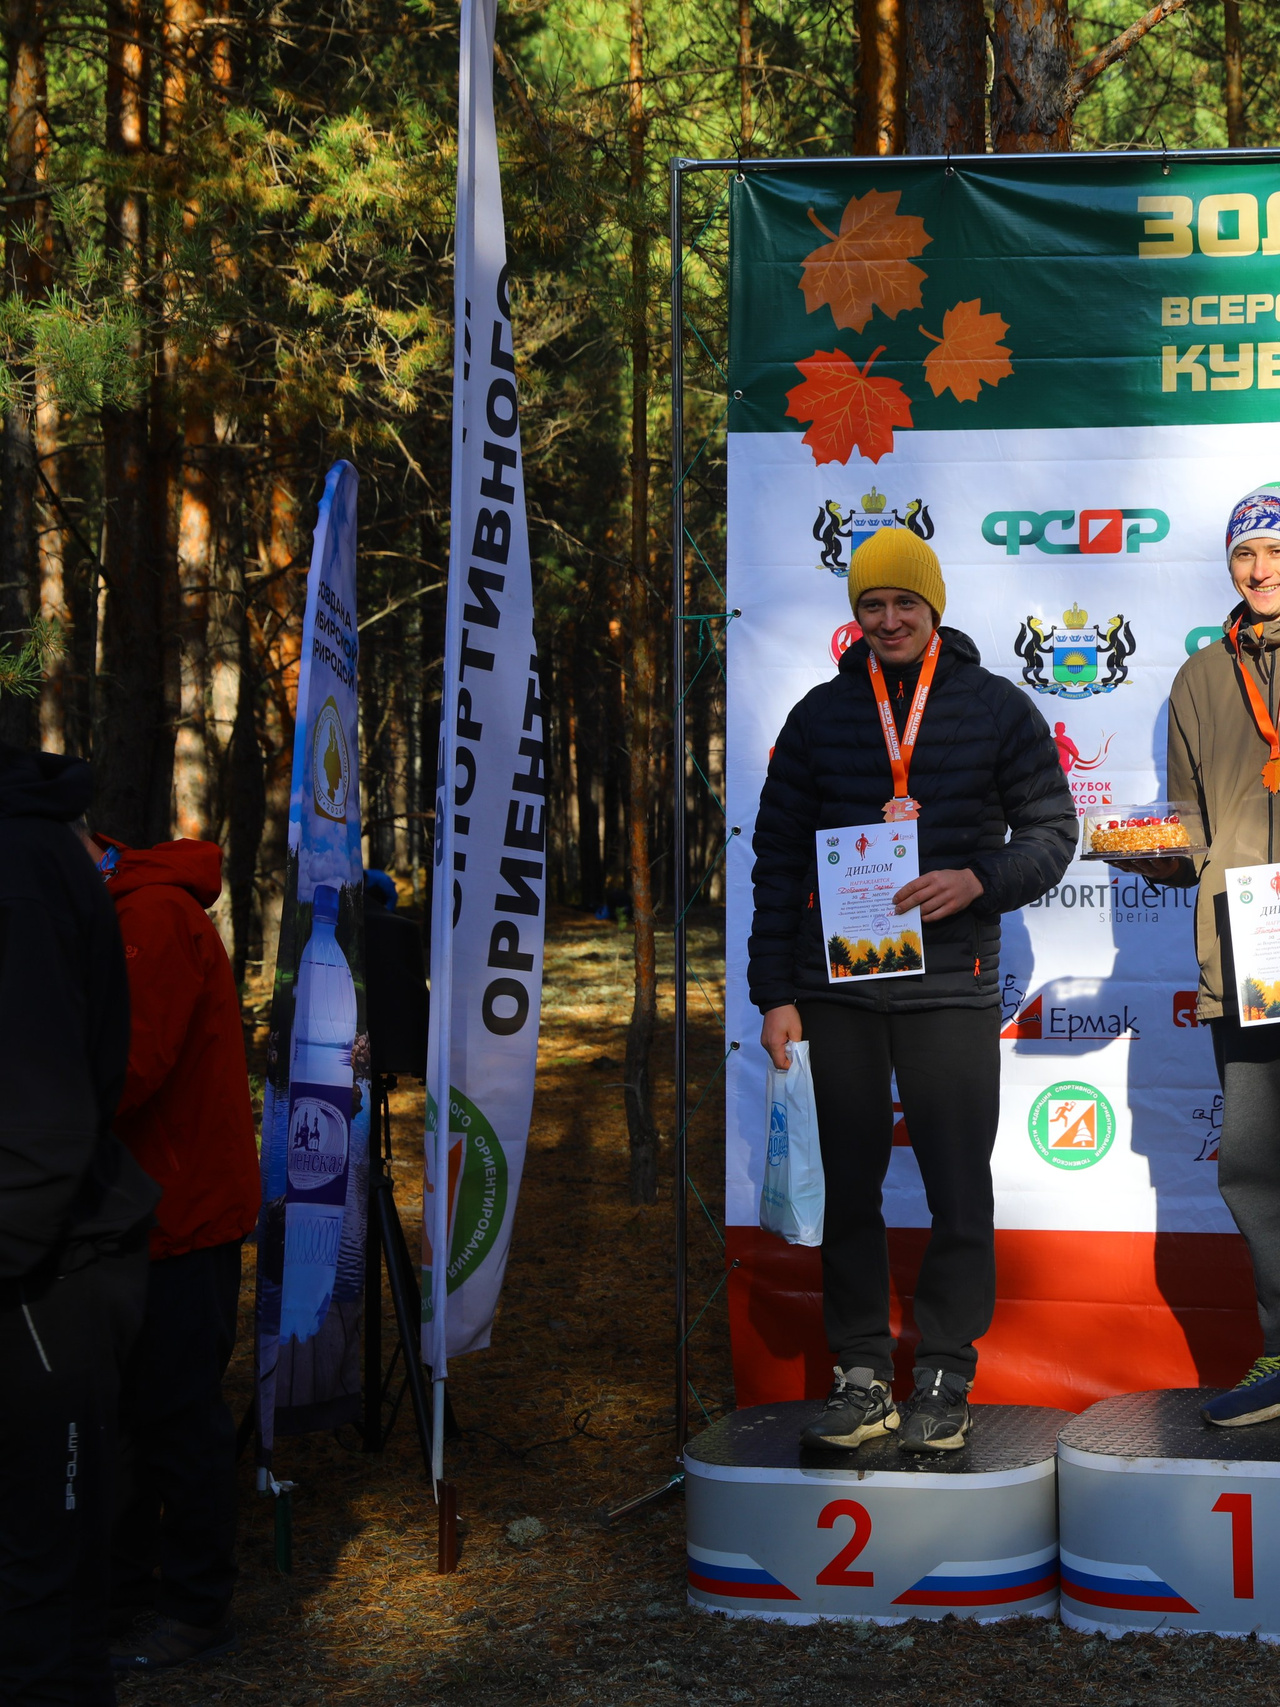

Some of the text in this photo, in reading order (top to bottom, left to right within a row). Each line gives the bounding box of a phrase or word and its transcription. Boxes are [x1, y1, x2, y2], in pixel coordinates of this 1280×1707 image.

[917, 685, 929, 711] ОСЕНЬ
[1071, 781, 1112, 792] КУБОК
[904, 801, 914, 811] 2
[845, 863, 893, 878] ДИПЛОМ
[1099, 908, 1160, 923] siberia
[1050, 1005, 1140, 1042] Ермак
[448, 1135, 497, 1280] ОРИЕНТИРОВАНИЯ
[816, 1499, 875, 1588] 2
[1211, 1492, 1255, 1600] 1
